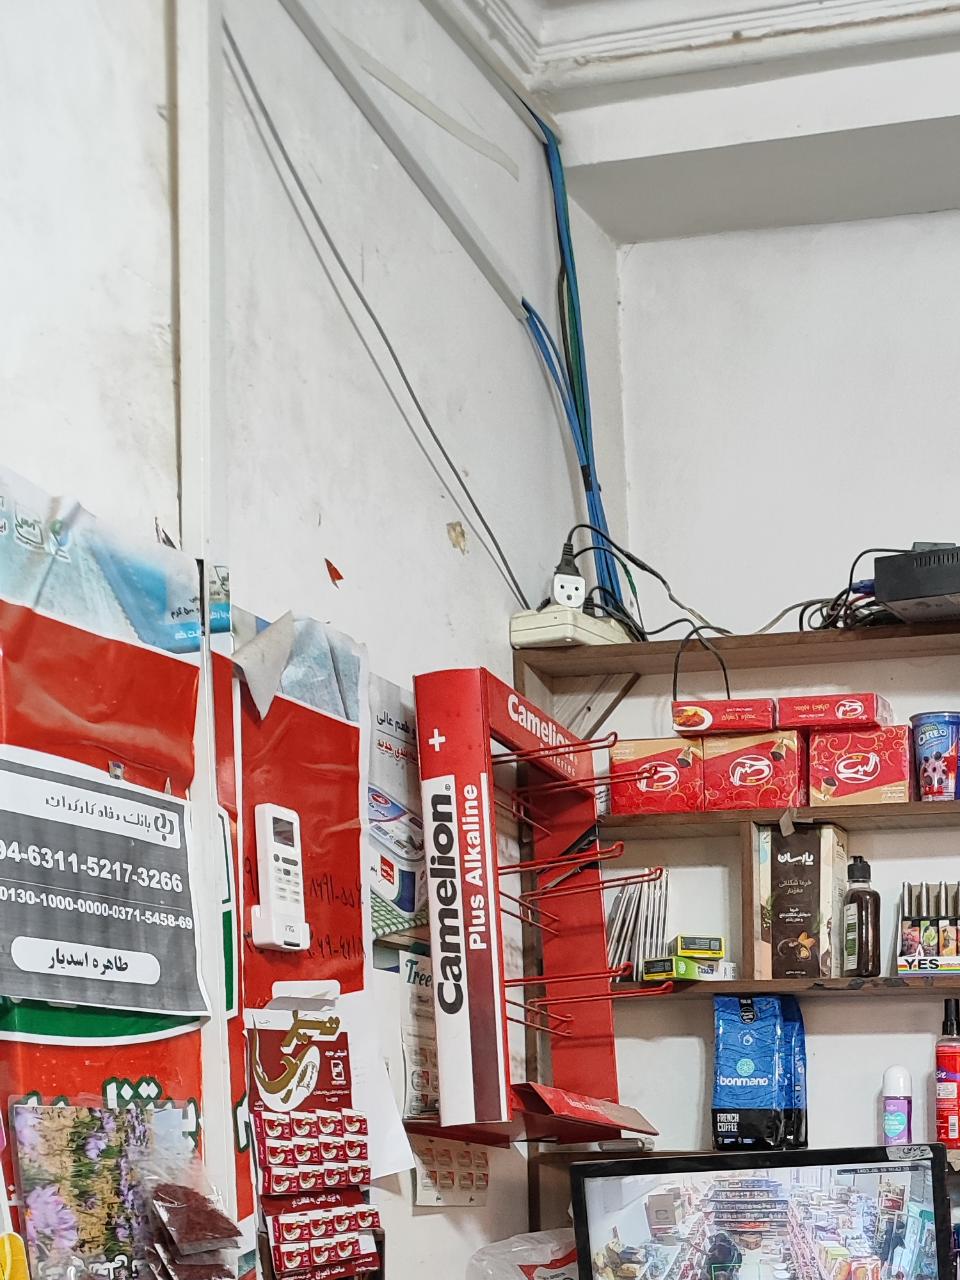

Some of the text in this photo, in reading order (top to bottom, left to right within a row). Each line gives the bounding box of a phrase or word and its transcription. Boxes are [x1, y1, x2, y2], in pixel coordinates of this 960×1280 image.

[507, 693, 576, 763] Camelion
[918, 727, 948, 746] OREO
[45, 795, 152, 832] بانک رفاه کارکنان
[461, 783, 488, 950] Plus Alkaline
[430, 793, 465, 1015] Camelion
[48, 948, 129, 975] طاهره اسدیار
[904, 958, 940, 971] YES
[719, 1076, 769, 1087] bonmano
[717, 1113, 740, 1123] FRENCH
[717, 1122, 739, 1133] COFFEE
